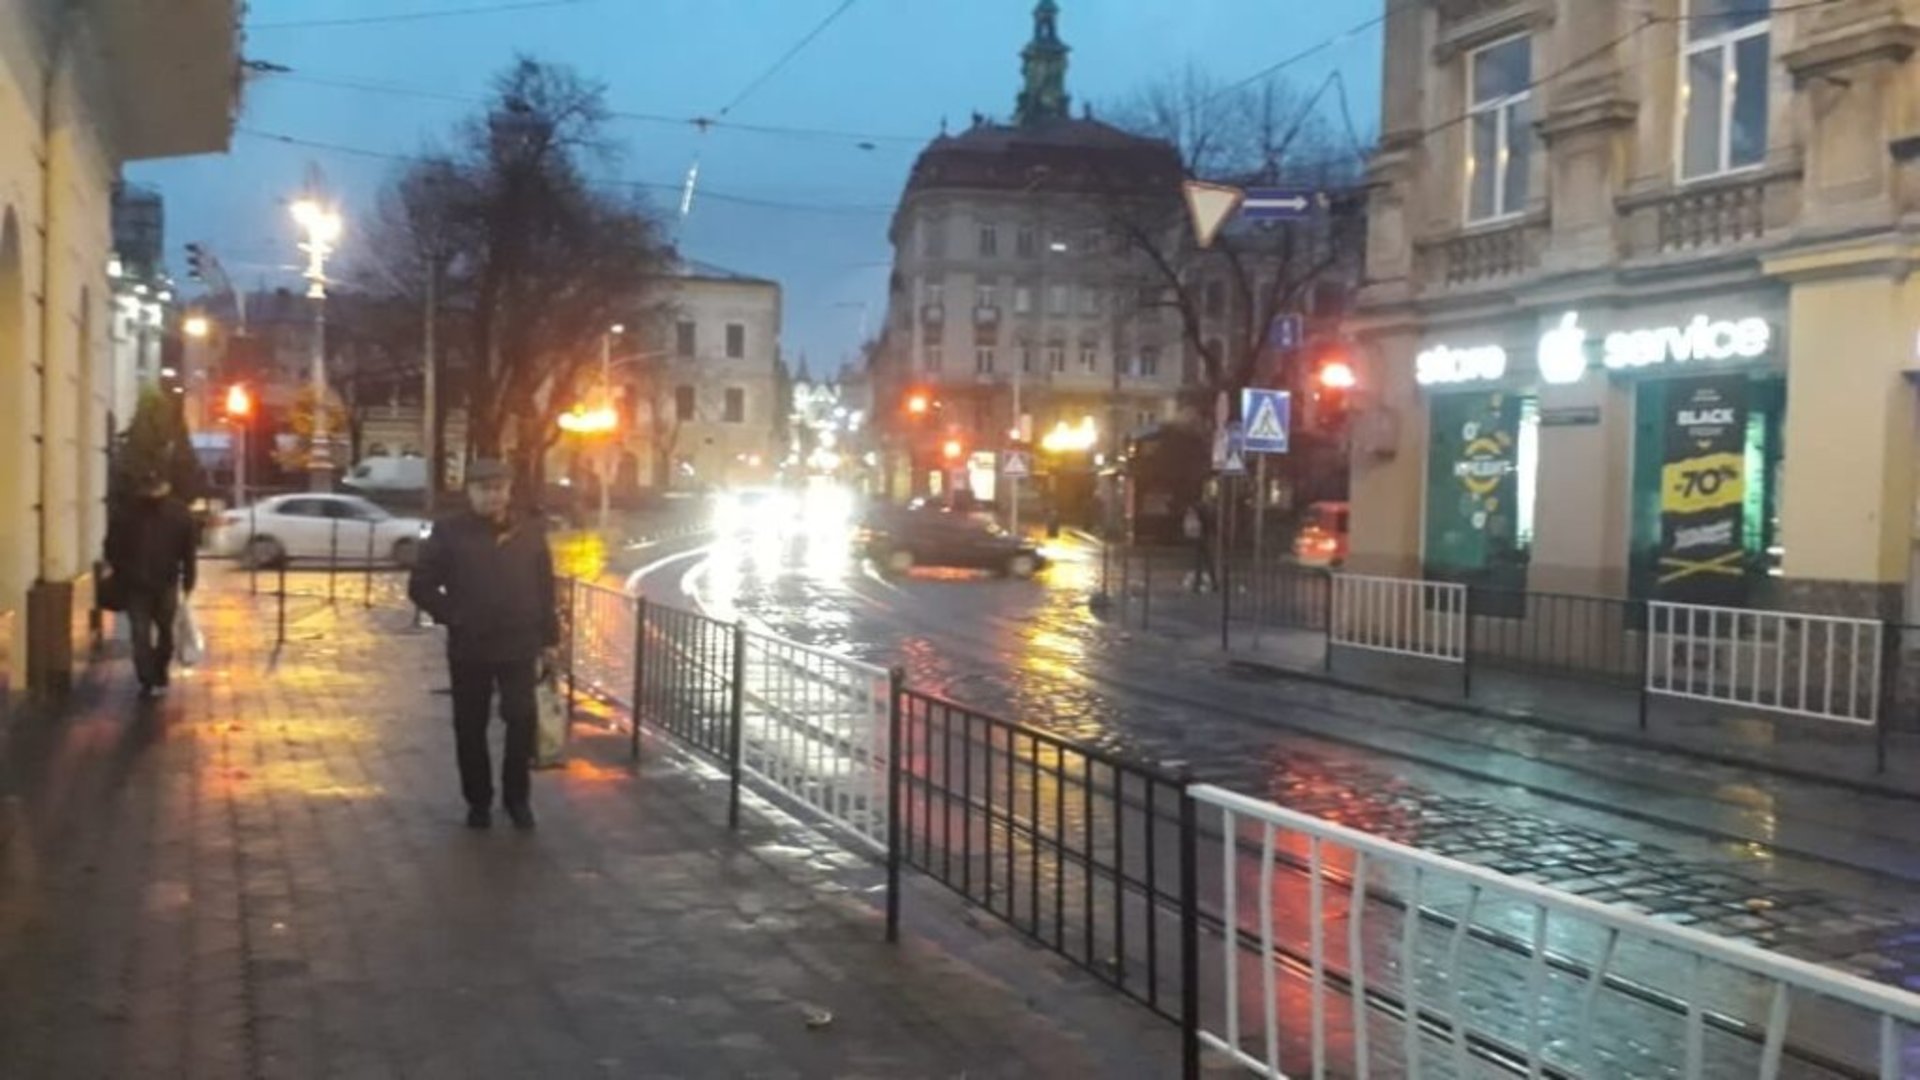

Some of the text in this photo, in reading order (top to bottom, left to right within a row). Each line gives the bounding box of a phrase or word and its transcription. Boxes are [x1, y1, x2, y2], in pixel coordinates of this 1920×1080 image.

[1416, 314, 1769, 385] store service
[1677, 407, 1735, 426] BLACK
